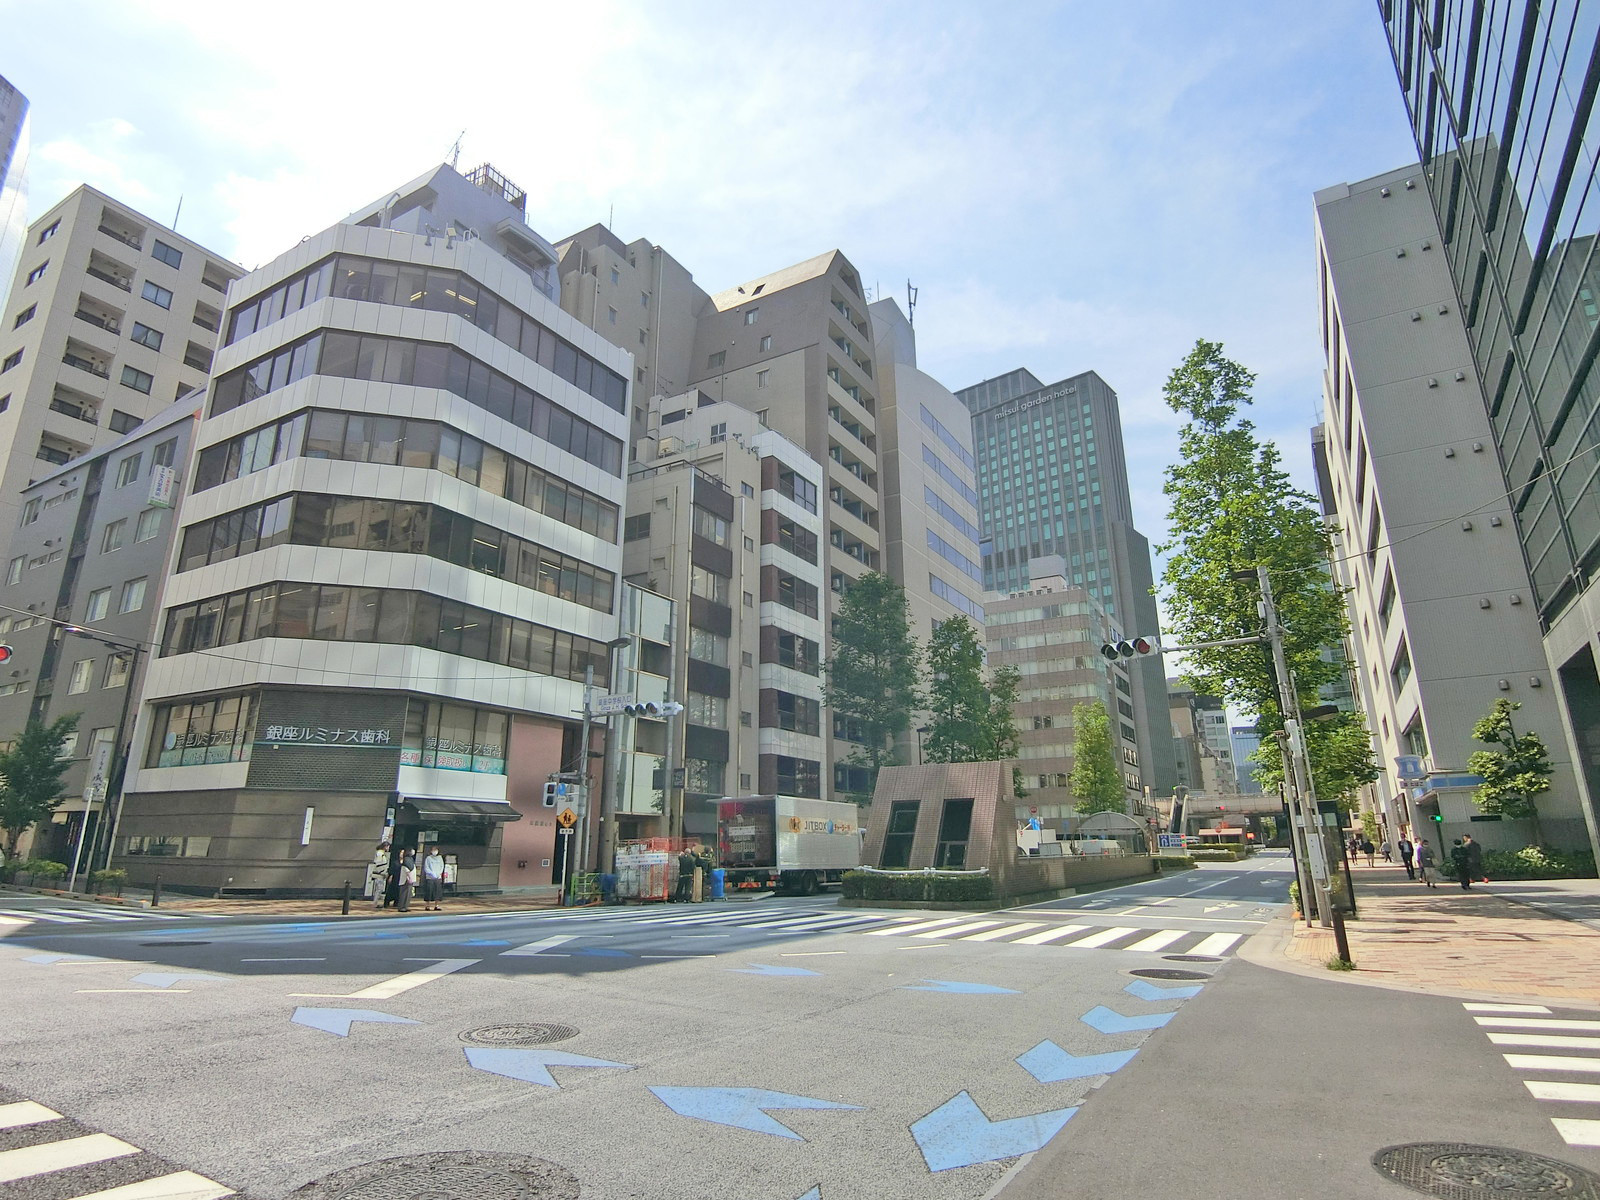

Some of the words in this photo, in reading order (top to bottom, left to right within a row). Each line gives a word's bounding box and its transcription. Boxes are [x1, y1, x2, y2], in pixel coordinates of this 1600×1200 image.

[994, 400, 1020, 420] mitsui
[1020, 392, 1053, 411] garden
[1054, 385, 1077, 399] hotel
[265, 725, 391, 744] 銀座ルミナス歯科
[804, 820, 827, 831] JITBOX
